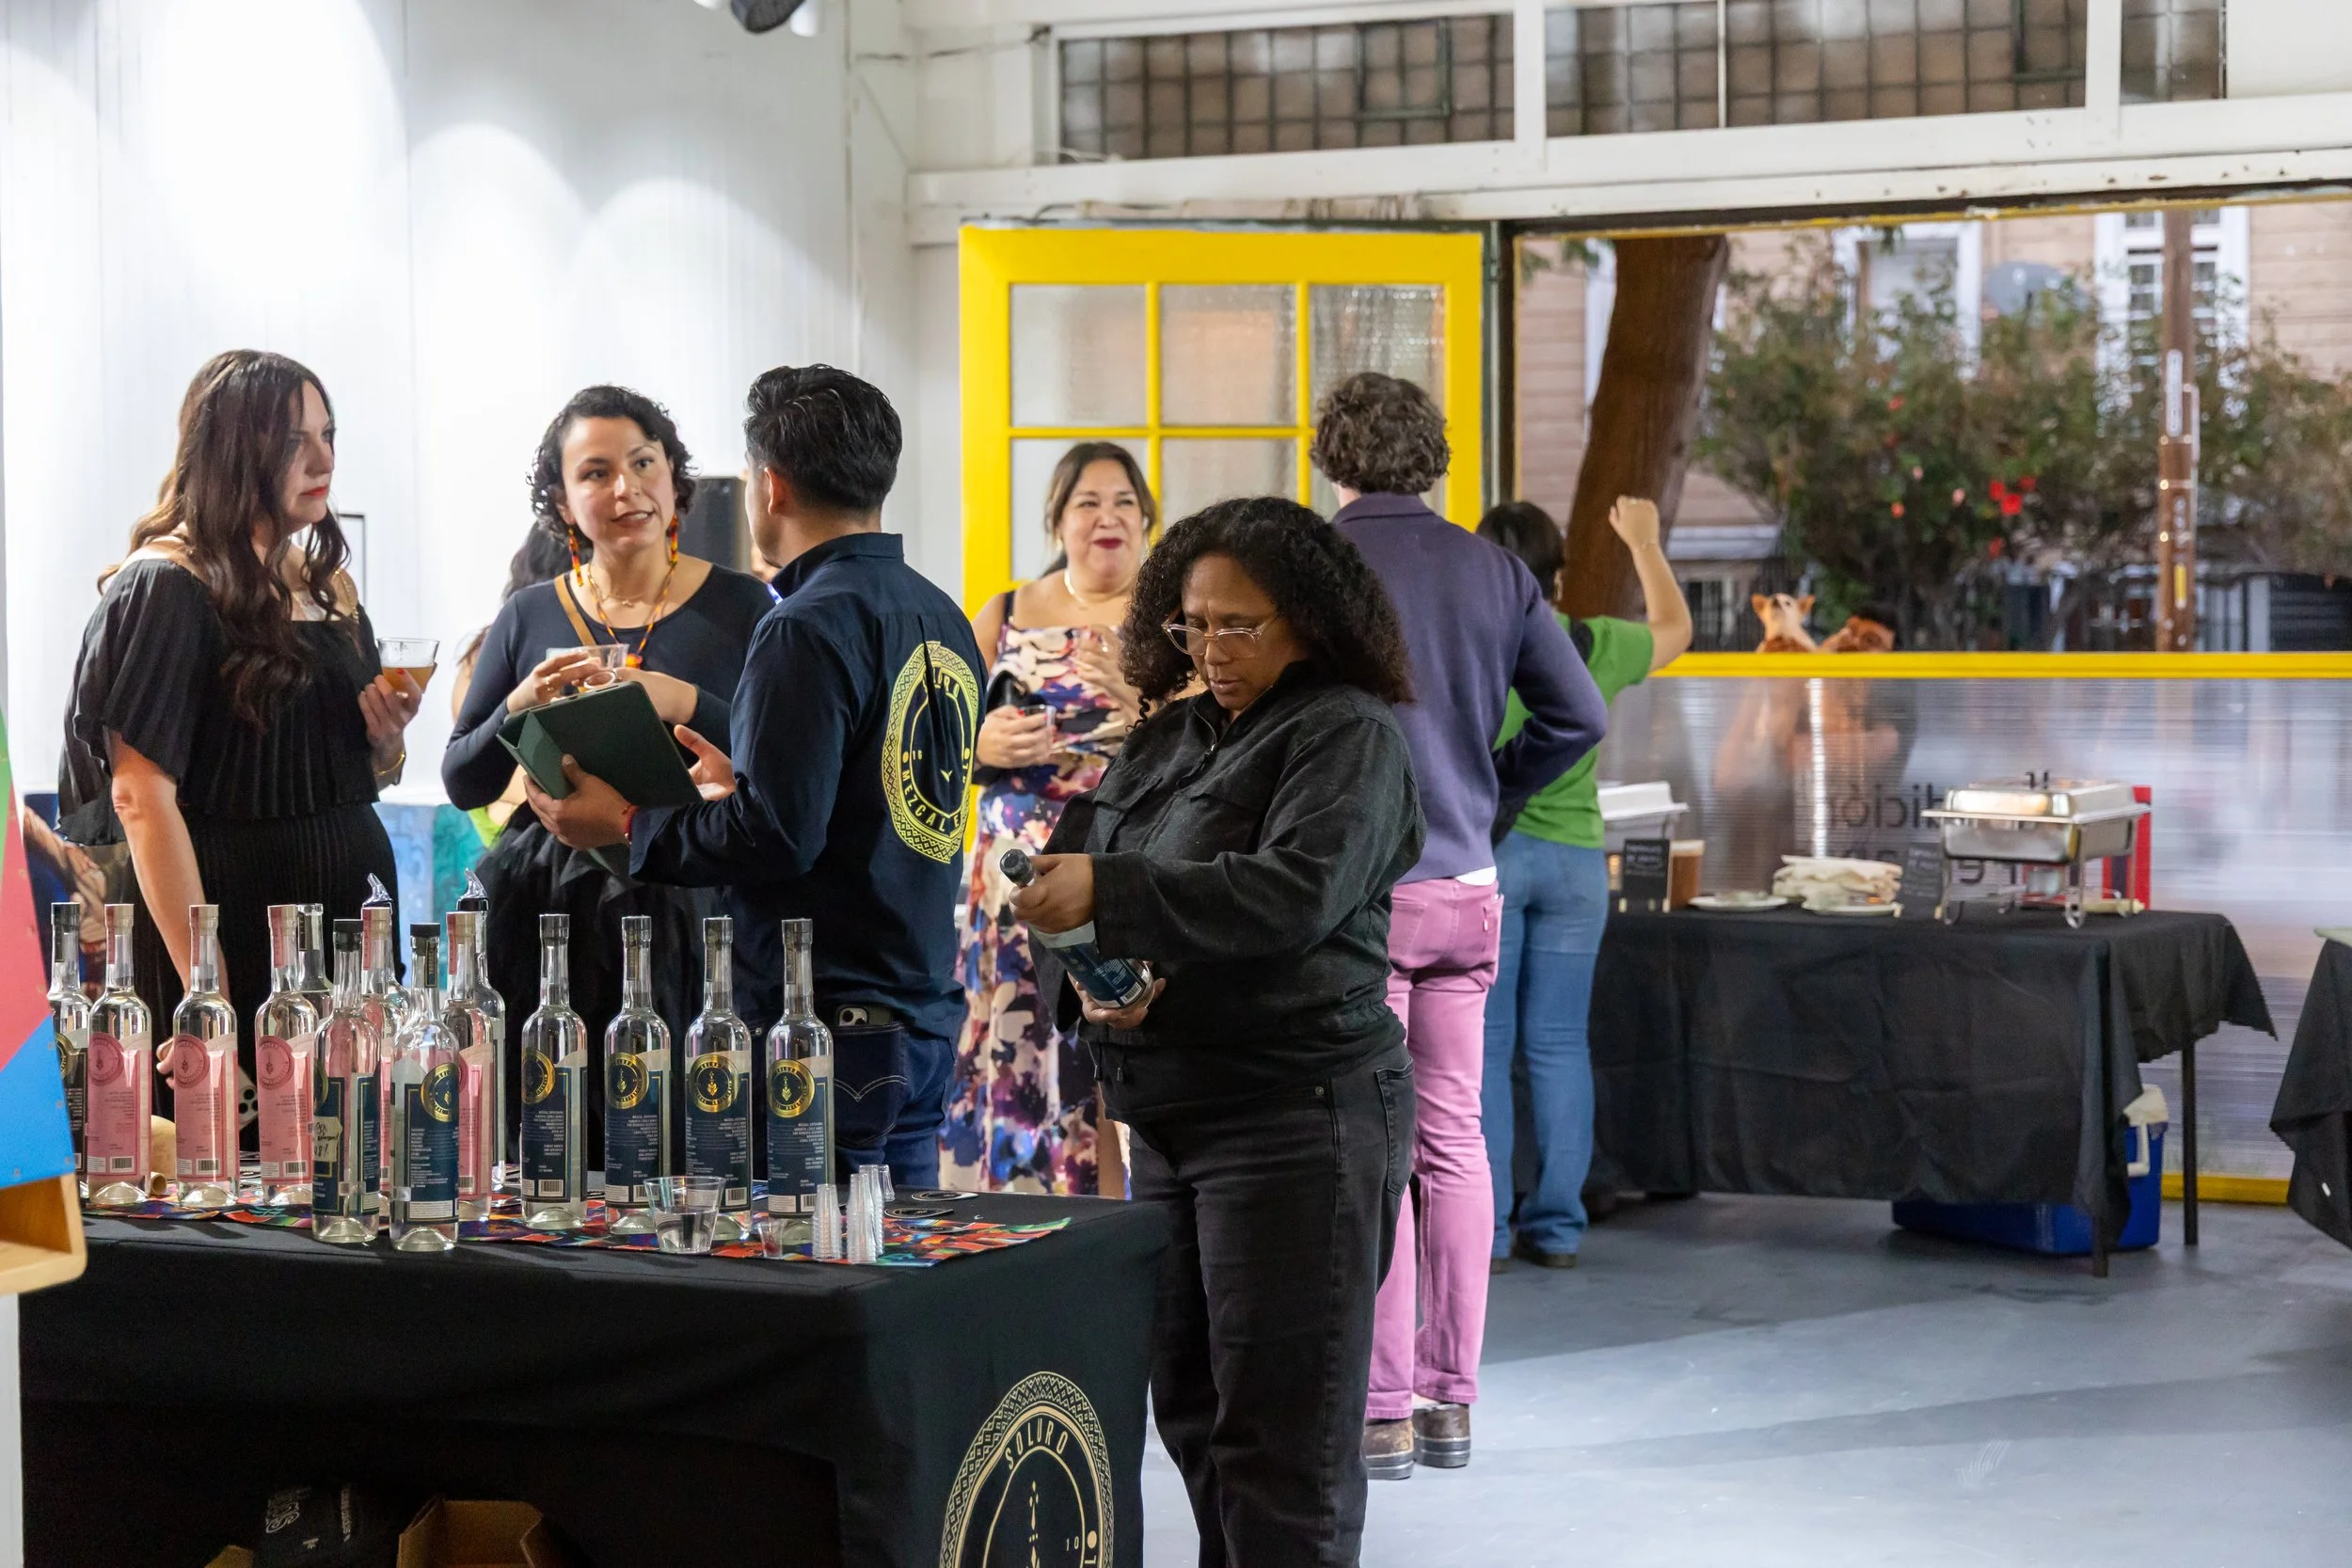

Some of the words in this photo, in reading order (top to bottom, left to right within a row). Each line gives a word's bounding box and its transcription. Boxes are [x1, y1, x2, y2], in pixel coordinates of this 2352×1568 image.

[901, 769, 946, 832] MEZCAL
[1005, 1418, 1069, 1471] SOLURO
[1066, 1536, 1080, 1552] 10
